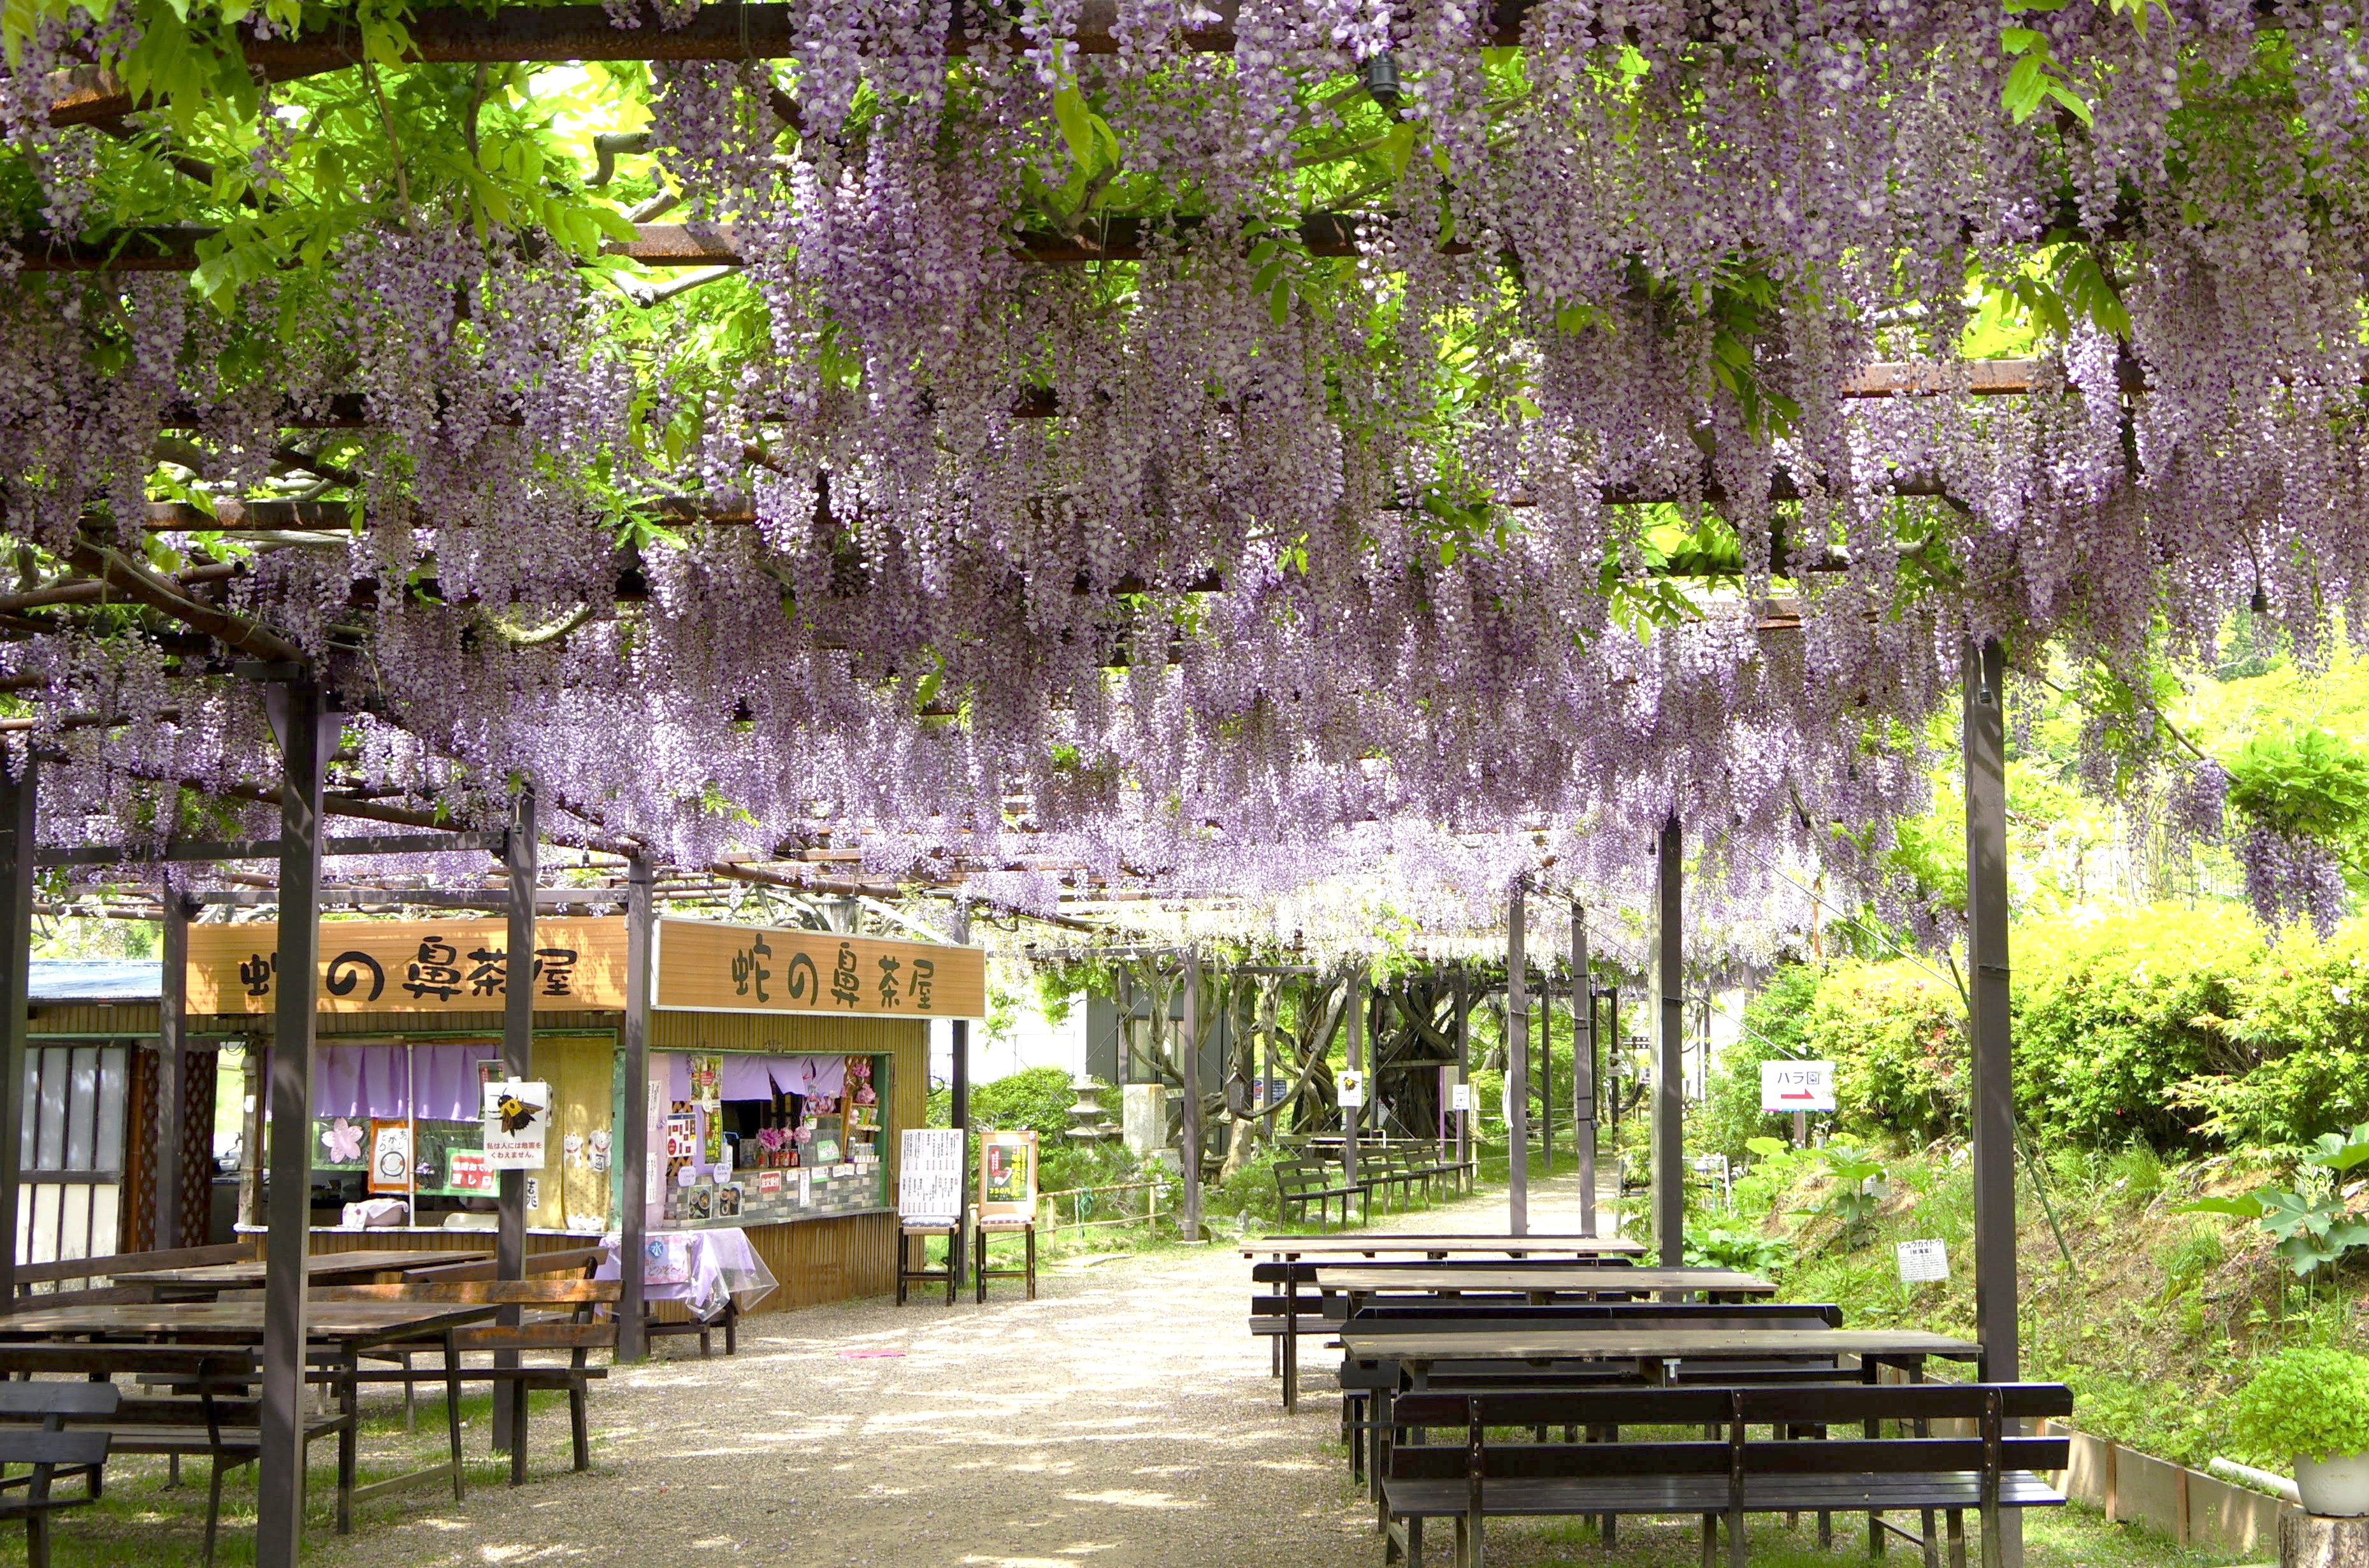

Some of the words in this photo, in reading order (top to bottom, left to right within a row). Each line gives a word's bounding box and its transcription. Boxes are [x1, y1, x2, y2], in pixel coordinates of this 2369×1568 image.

[732, 933, 934, 1009] 蛇の鼻茶屋
[651, 1242, 662, 1256] 水
